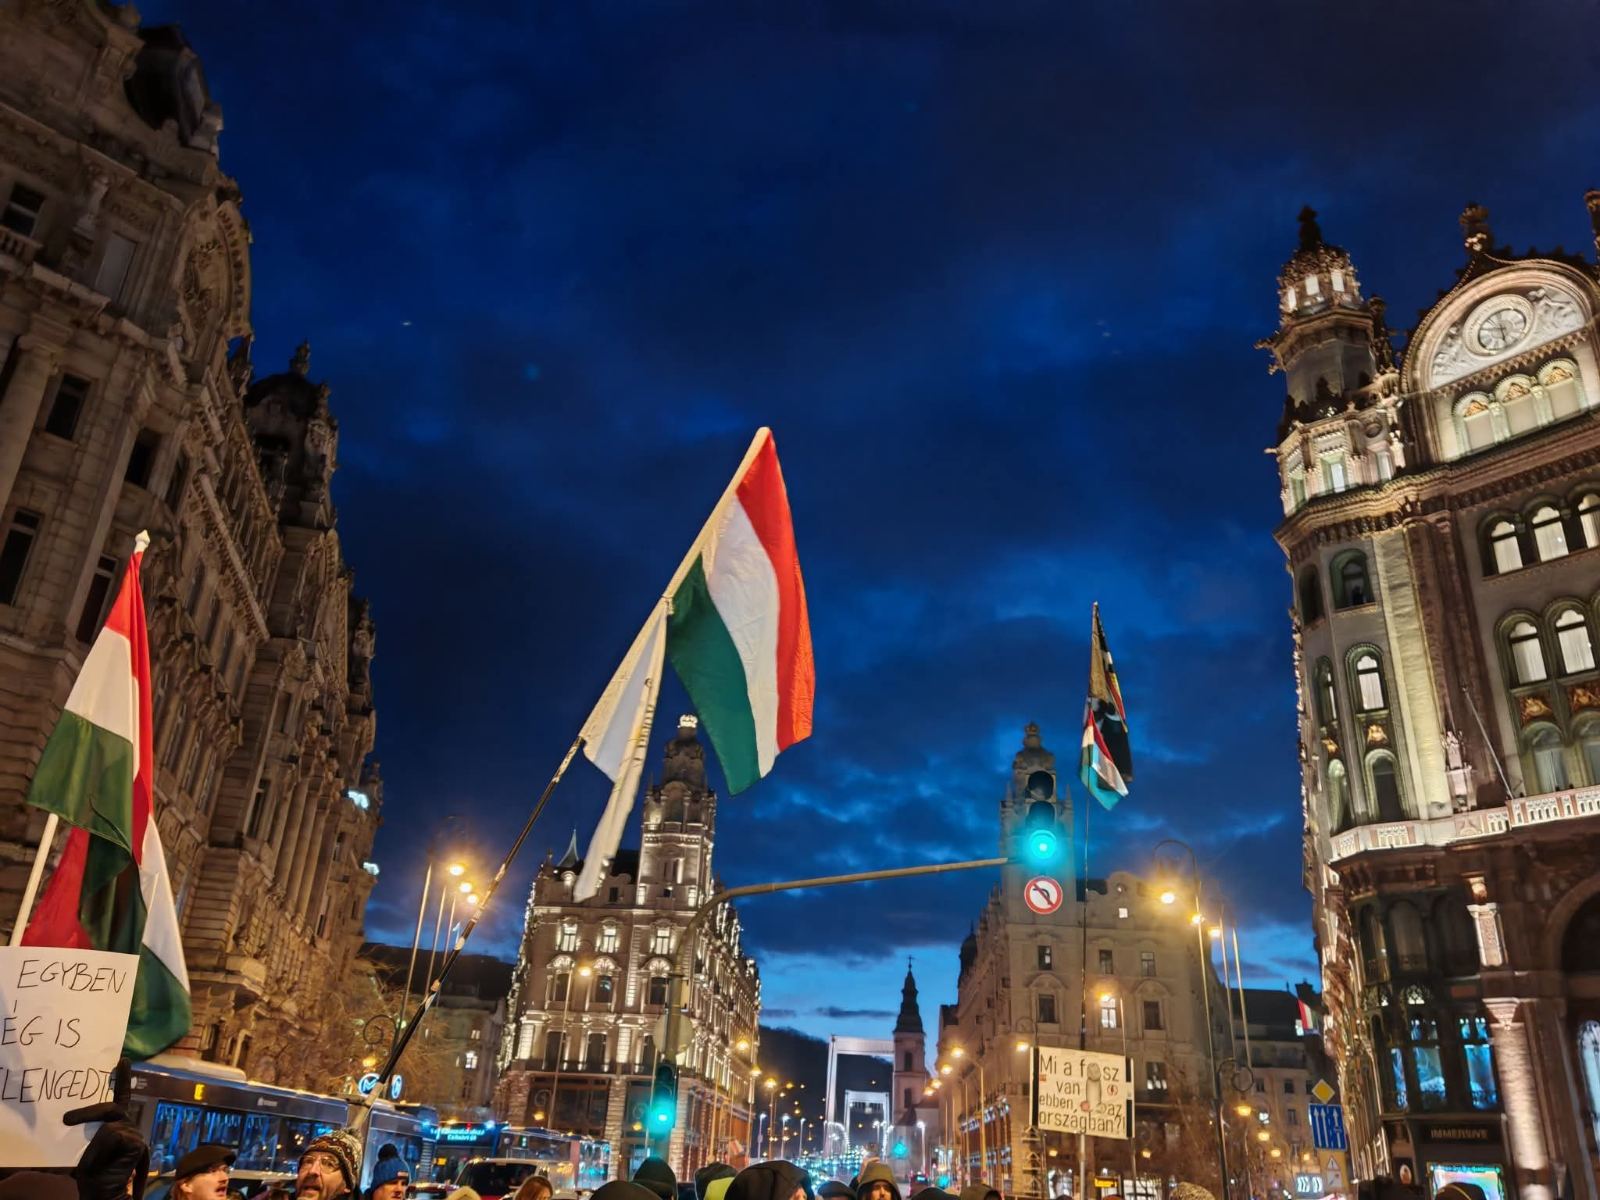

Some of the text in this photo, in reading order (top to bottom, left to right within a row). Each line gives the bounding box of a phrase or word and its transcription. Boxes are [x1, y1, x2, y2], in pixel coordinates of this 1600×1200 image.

[17, 960, 127, 993] EGYBEN
[54, 1018, 81, 1048] IS
[1040, 1054, 1057, 1075] Mi
[1063, 1061, 1072, 1076] a
[0, 1067, 114, 1104] LENGEDT
[1056, 1081, 1080, 1095] van
[1039, 1093, 1073, 1109] ebben
